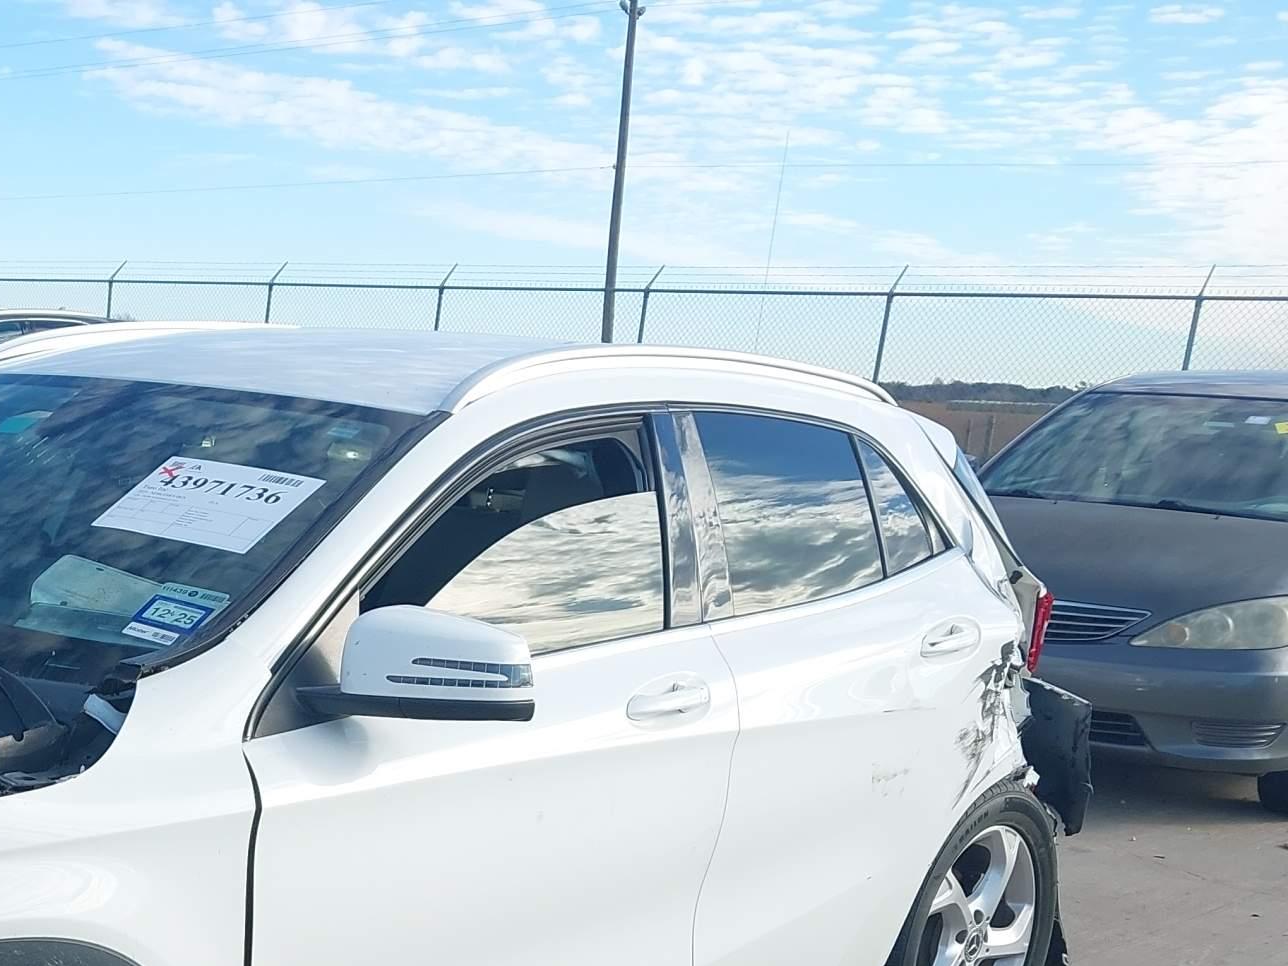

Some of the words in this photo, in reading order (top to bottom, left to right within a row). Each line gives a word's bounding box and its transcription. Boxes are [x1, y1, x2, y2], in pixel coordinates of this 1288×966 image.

[160, 474, 289, 506] 43971736
[150, 606, 170, 619] 12
[173, 612, 198, 626] 25
